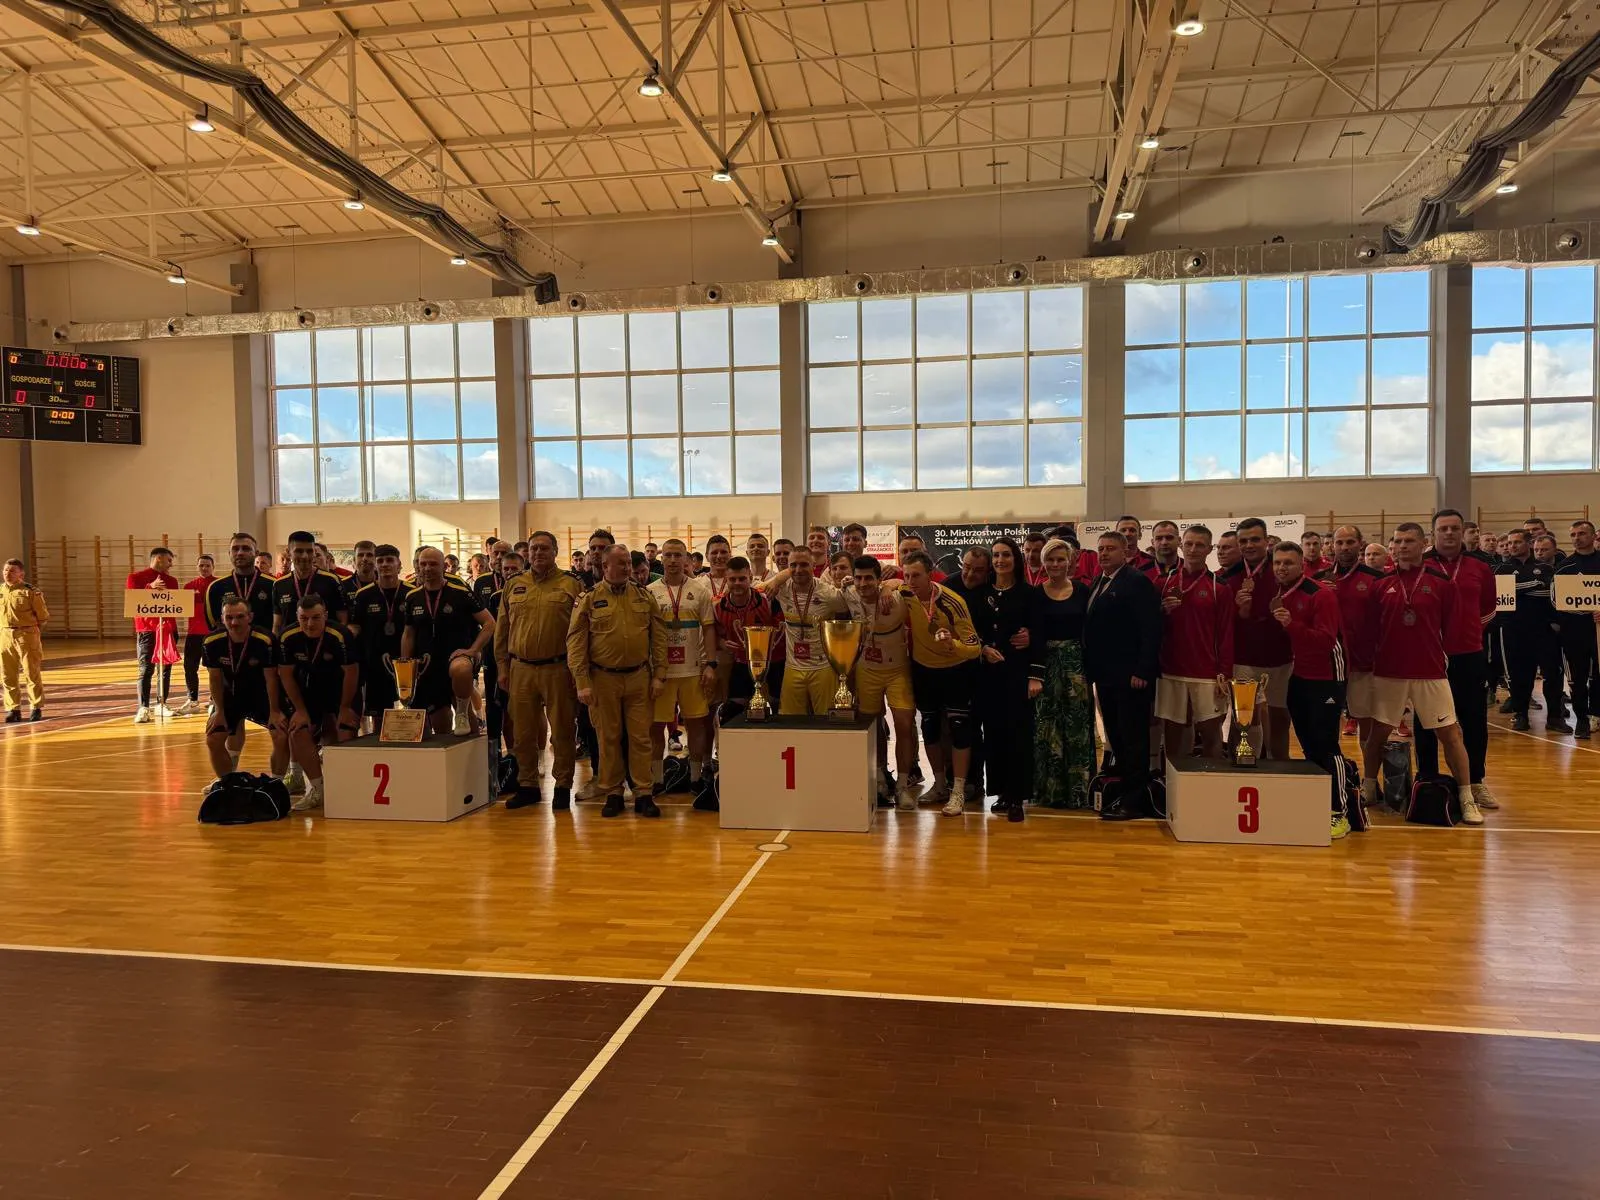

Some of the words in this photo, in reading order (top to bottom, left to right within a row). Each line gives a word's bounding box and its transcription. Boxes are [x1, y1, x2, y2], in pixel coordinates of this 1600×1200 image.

[11, 375, 52, 385] GOSPODARZE
[75, 379, 97, 388] GOŚCIE
[16, 390, 26, 403] 0
[85, 395, 95, 408] 0
[935, 529, 948, 537] 30.
[950, 529, 1003, 537] Mistrzostwa
[1004, 527, 1030, 536] Polski
[935, 537, 984, 546] Strażaków
[1582, 580, 1600, 588] wo
[151, 591, 174, 601] woj.
[1496, 594, 1514, 606] skie
[137, 604, 183, 614] łódzkie
[781, 747, 795, 790] 1
[373, 763, 390, 805] 2
[1238, 786, 1259, 834] 3
